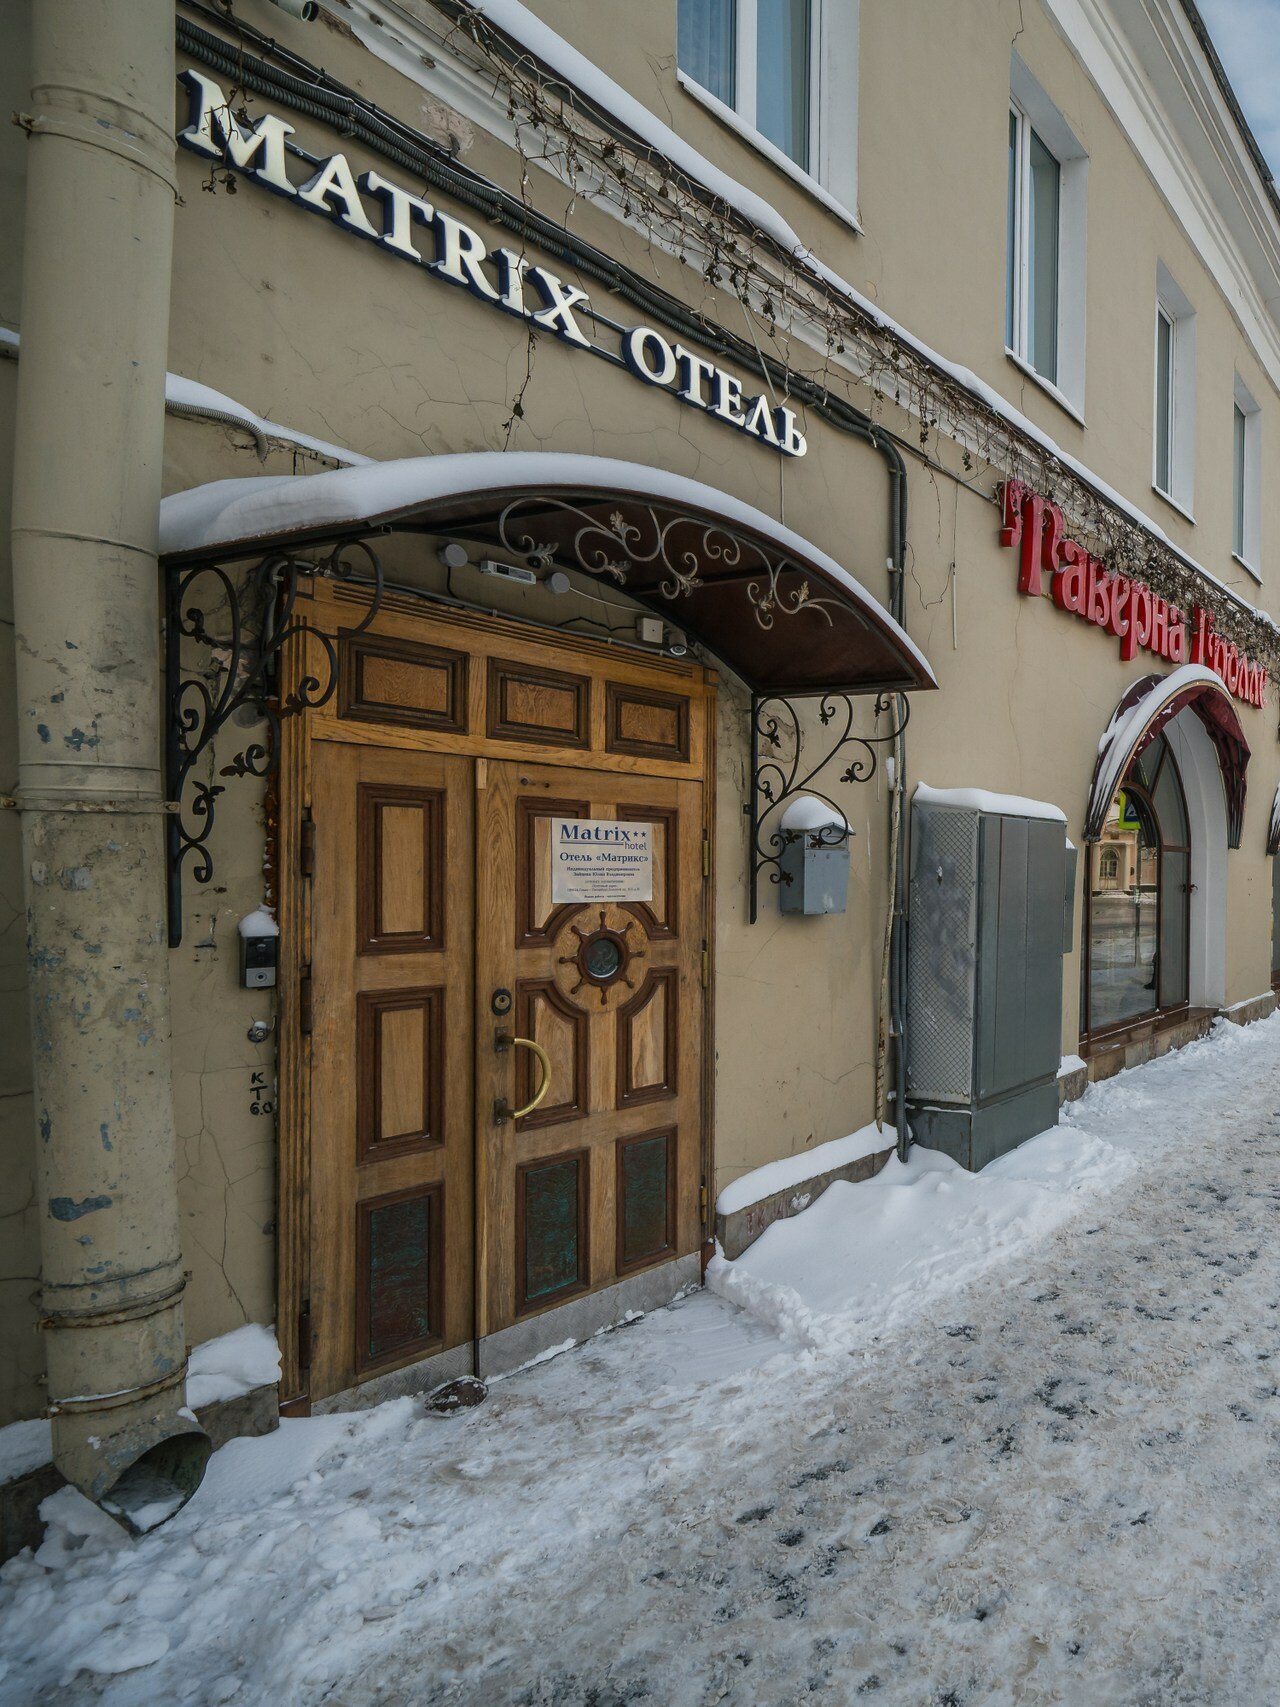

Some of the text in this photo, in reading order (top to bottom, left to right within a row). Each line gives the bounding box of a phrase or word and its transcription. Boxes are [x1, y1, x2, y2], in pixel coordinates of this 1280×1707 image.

[177, 69, 807, 458] MATRIX ОТЕЛЬ
[1000, 479, 1186, 664] Таверна
[560, 824, 631, 842] Matrix
[625, 842, 647, 850] hotel
[560, 852, 592, 862] Отель
